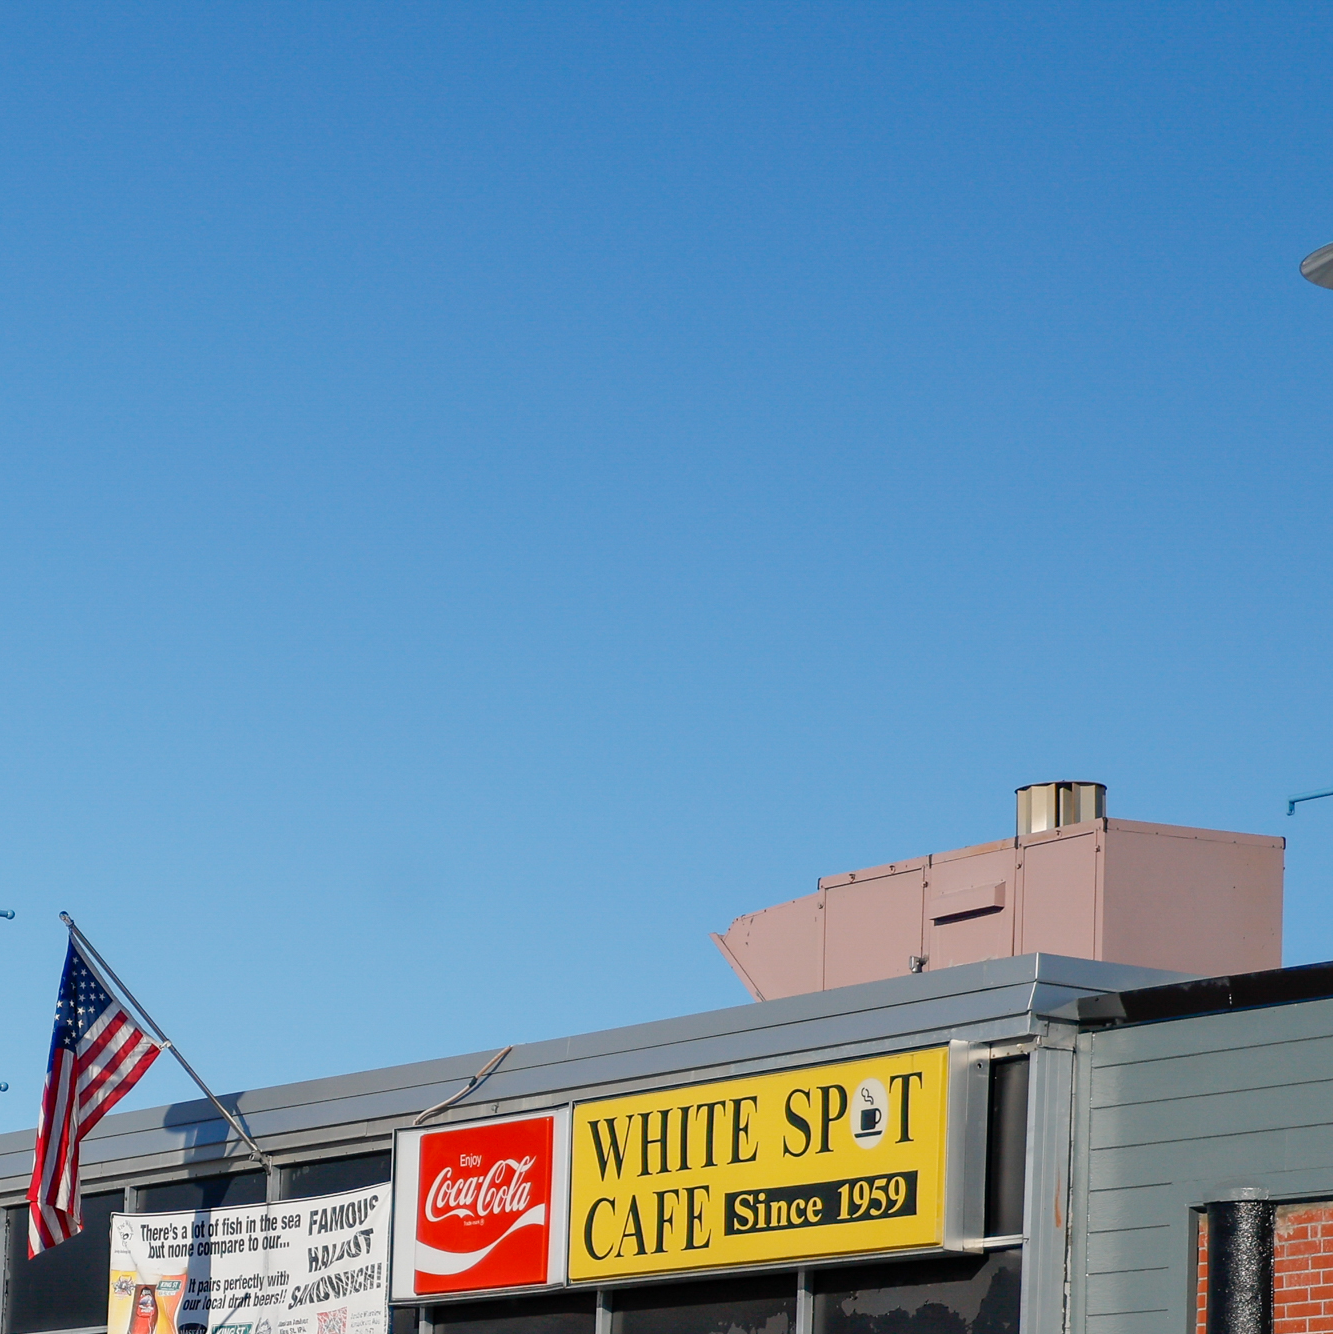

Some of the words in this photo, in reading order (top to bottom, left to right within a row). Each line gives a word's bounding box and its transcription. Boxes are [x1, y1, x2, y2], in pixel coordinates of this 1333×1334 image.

[587, 1095, 759, 1182] WHITE
[460, 1153, 482, 1168] Enjoy
[425, 1155, 537, 1222] Coca-Cola
[140, 1222, 178, 1242] There's
[181, 1225, 188, 1239] a
[191, 1220, 205, 1239] lot
[208, 1218, 219, 1237] of
[221, 1216, 242, 1236] fish
[246, 1215, 258, 1233] in
[260, 1213, 278, 1232] the
[281, 1213, 301, 1230] sea
[583, 1185, 712, 1261] CAFE
[733, 1193, 823, 1231] Since
[836, 1176, 907, 1221] 1959
[147, 1242, 165, 1259] but
[167, 1243, 194, 1258] none
[197, 1238, 245, 1258] compare
[248, 1235, 258, 1251] to
[188, 1278, 195, 1293] It
[197, 1277, 220, 1296] pairs
[223, 1274, 265, 1294] perfectly
[267, 1270, 290, 1287] with
[183, 1296, 200, 1311] our
[203, 1293, 226, 1310] local
[228, 1292, 252, 1309] draft
